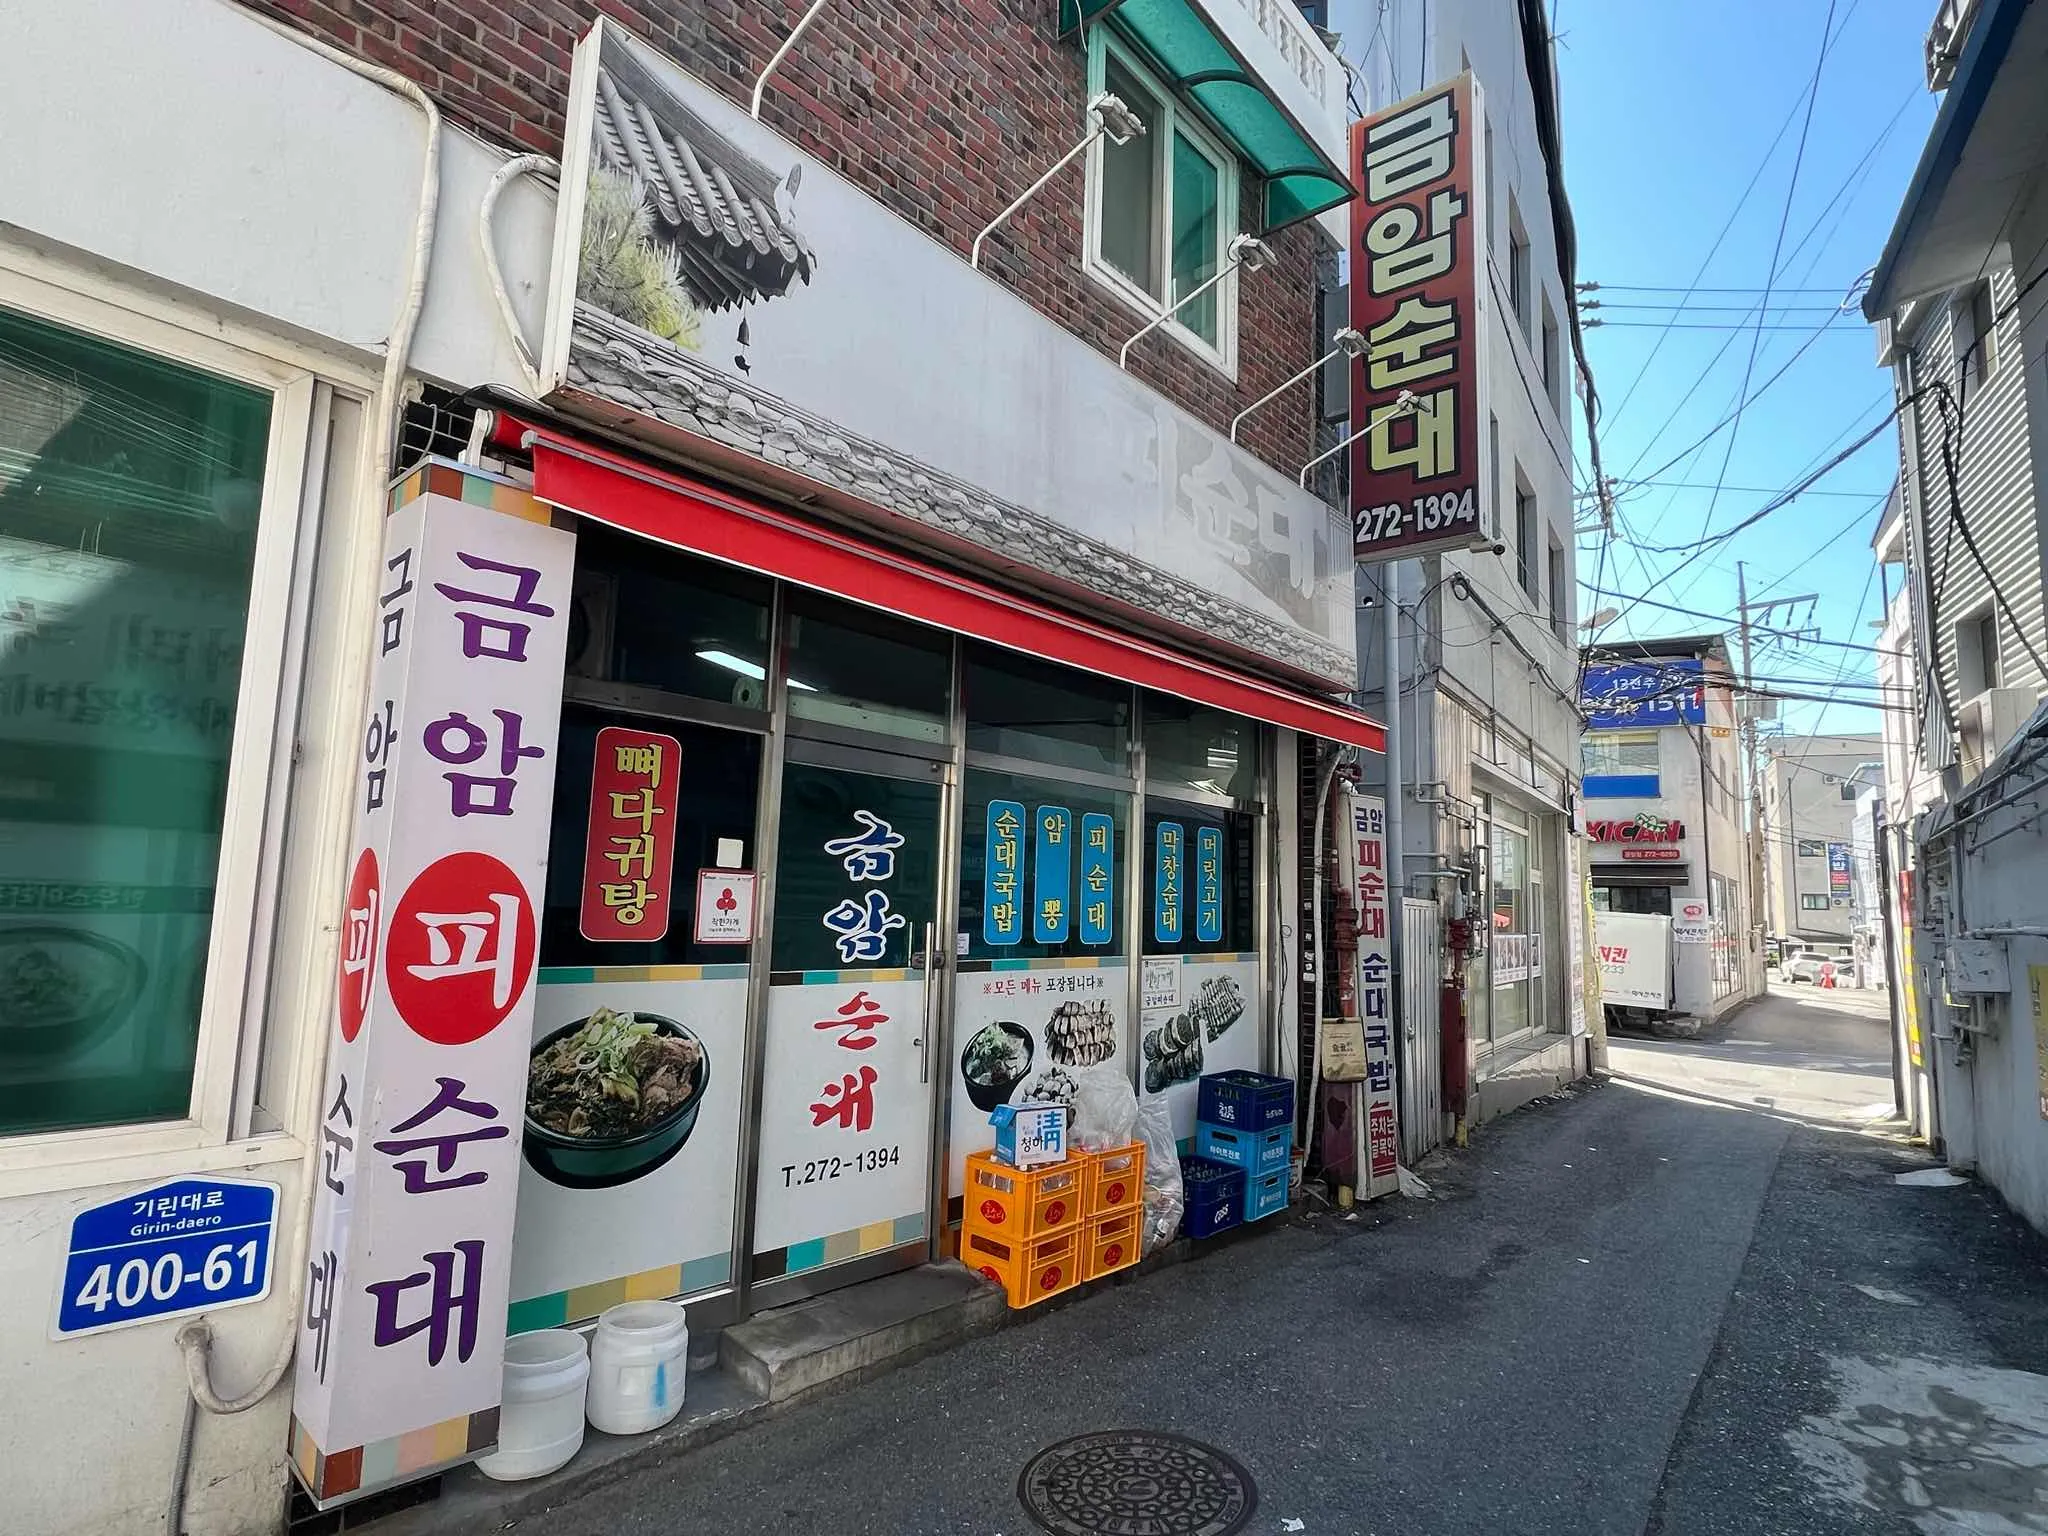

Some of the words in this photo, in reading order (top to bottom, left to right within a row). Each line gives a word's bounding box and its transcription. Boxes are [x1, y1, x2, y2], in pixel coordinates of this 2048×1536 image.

[1365, 92, 1464, 480] 금암순대
[1355, 487, 1476, 545] 272-1394
[601, 743, 665, 925] 뼈다귀탕
[1355, 806, 1384, 834] 금암
[823, 809, 905, 962] 금암
[992, 809, 1020, 933] 순대국밥
[1087, 827, 1108, 931] 피순대
[1161, 830, 1180, 932] 막창순대
[1203, 836, 1218, 932] 머릿고기
[1357, 838, 1386, 940] 피순대
[1020, 977, 1041, 994] 메뉴
[1363, 951, 1390, 1093] 순대국밥
[1021, 1136, 1043, 1152] 청하
[1371, 1116, 1395, 1136] 주차는
[1372, 1137, 1396, 1158] 골목안
[132, 1190, 225, 1218] 기린대로
[781, 1145, 900, 1188] T.272-1394
[129, 1213, 222, 1236] Girin-daero
[75, 1239, 258, 1314] 400-61
